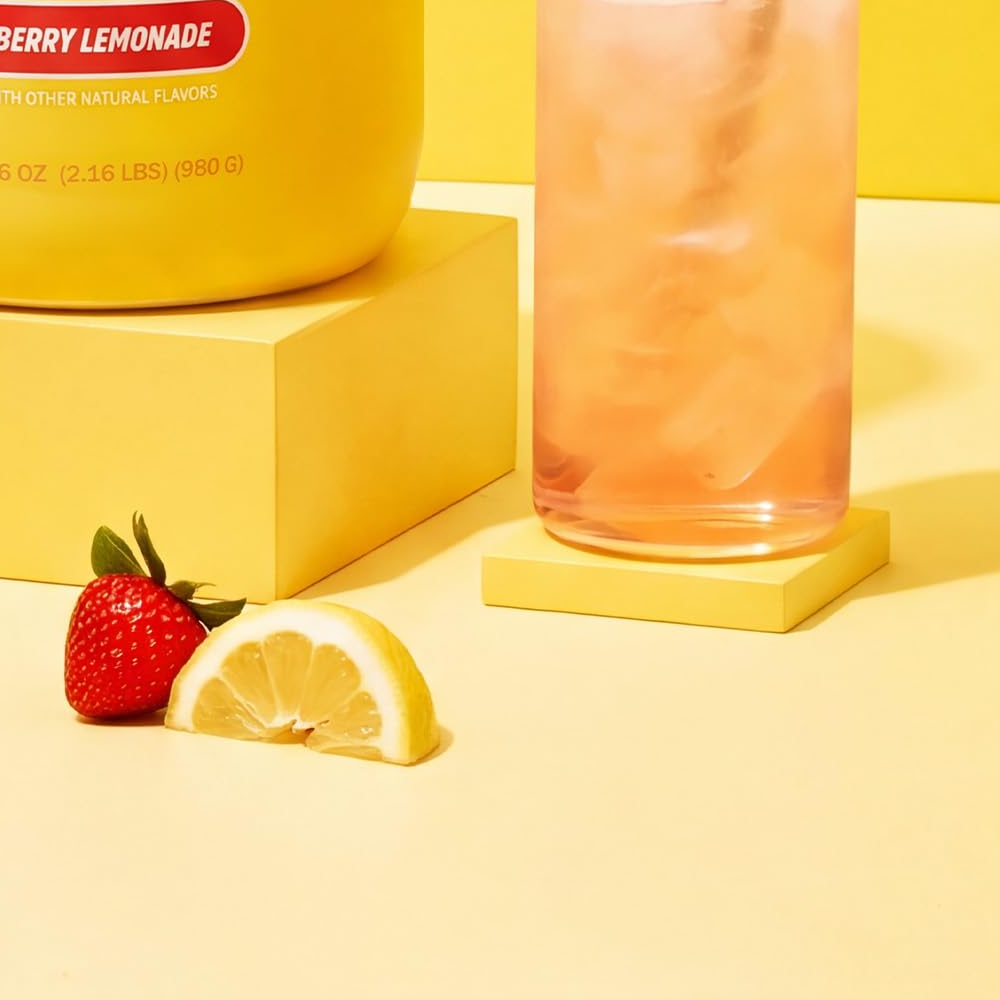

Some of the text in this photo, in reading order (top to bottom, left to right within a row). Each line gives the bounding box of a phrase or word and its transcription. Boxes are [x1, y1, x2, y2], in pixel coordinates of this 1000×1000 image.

[80, 21, 213, 53] LEMONADE
[25, 90, 76, 106] OTHER
[81, 88, 150, 106] NATURAL
[154, 84, 217, 103] FLAVORS
[18, 164, 47, 182] OZ
[60, 162, 114, 187] (2.16
[122, 161, 168, 184] LBS)
[175, 157, 219, 182] (980
[224, 154, 244, 175] G)
